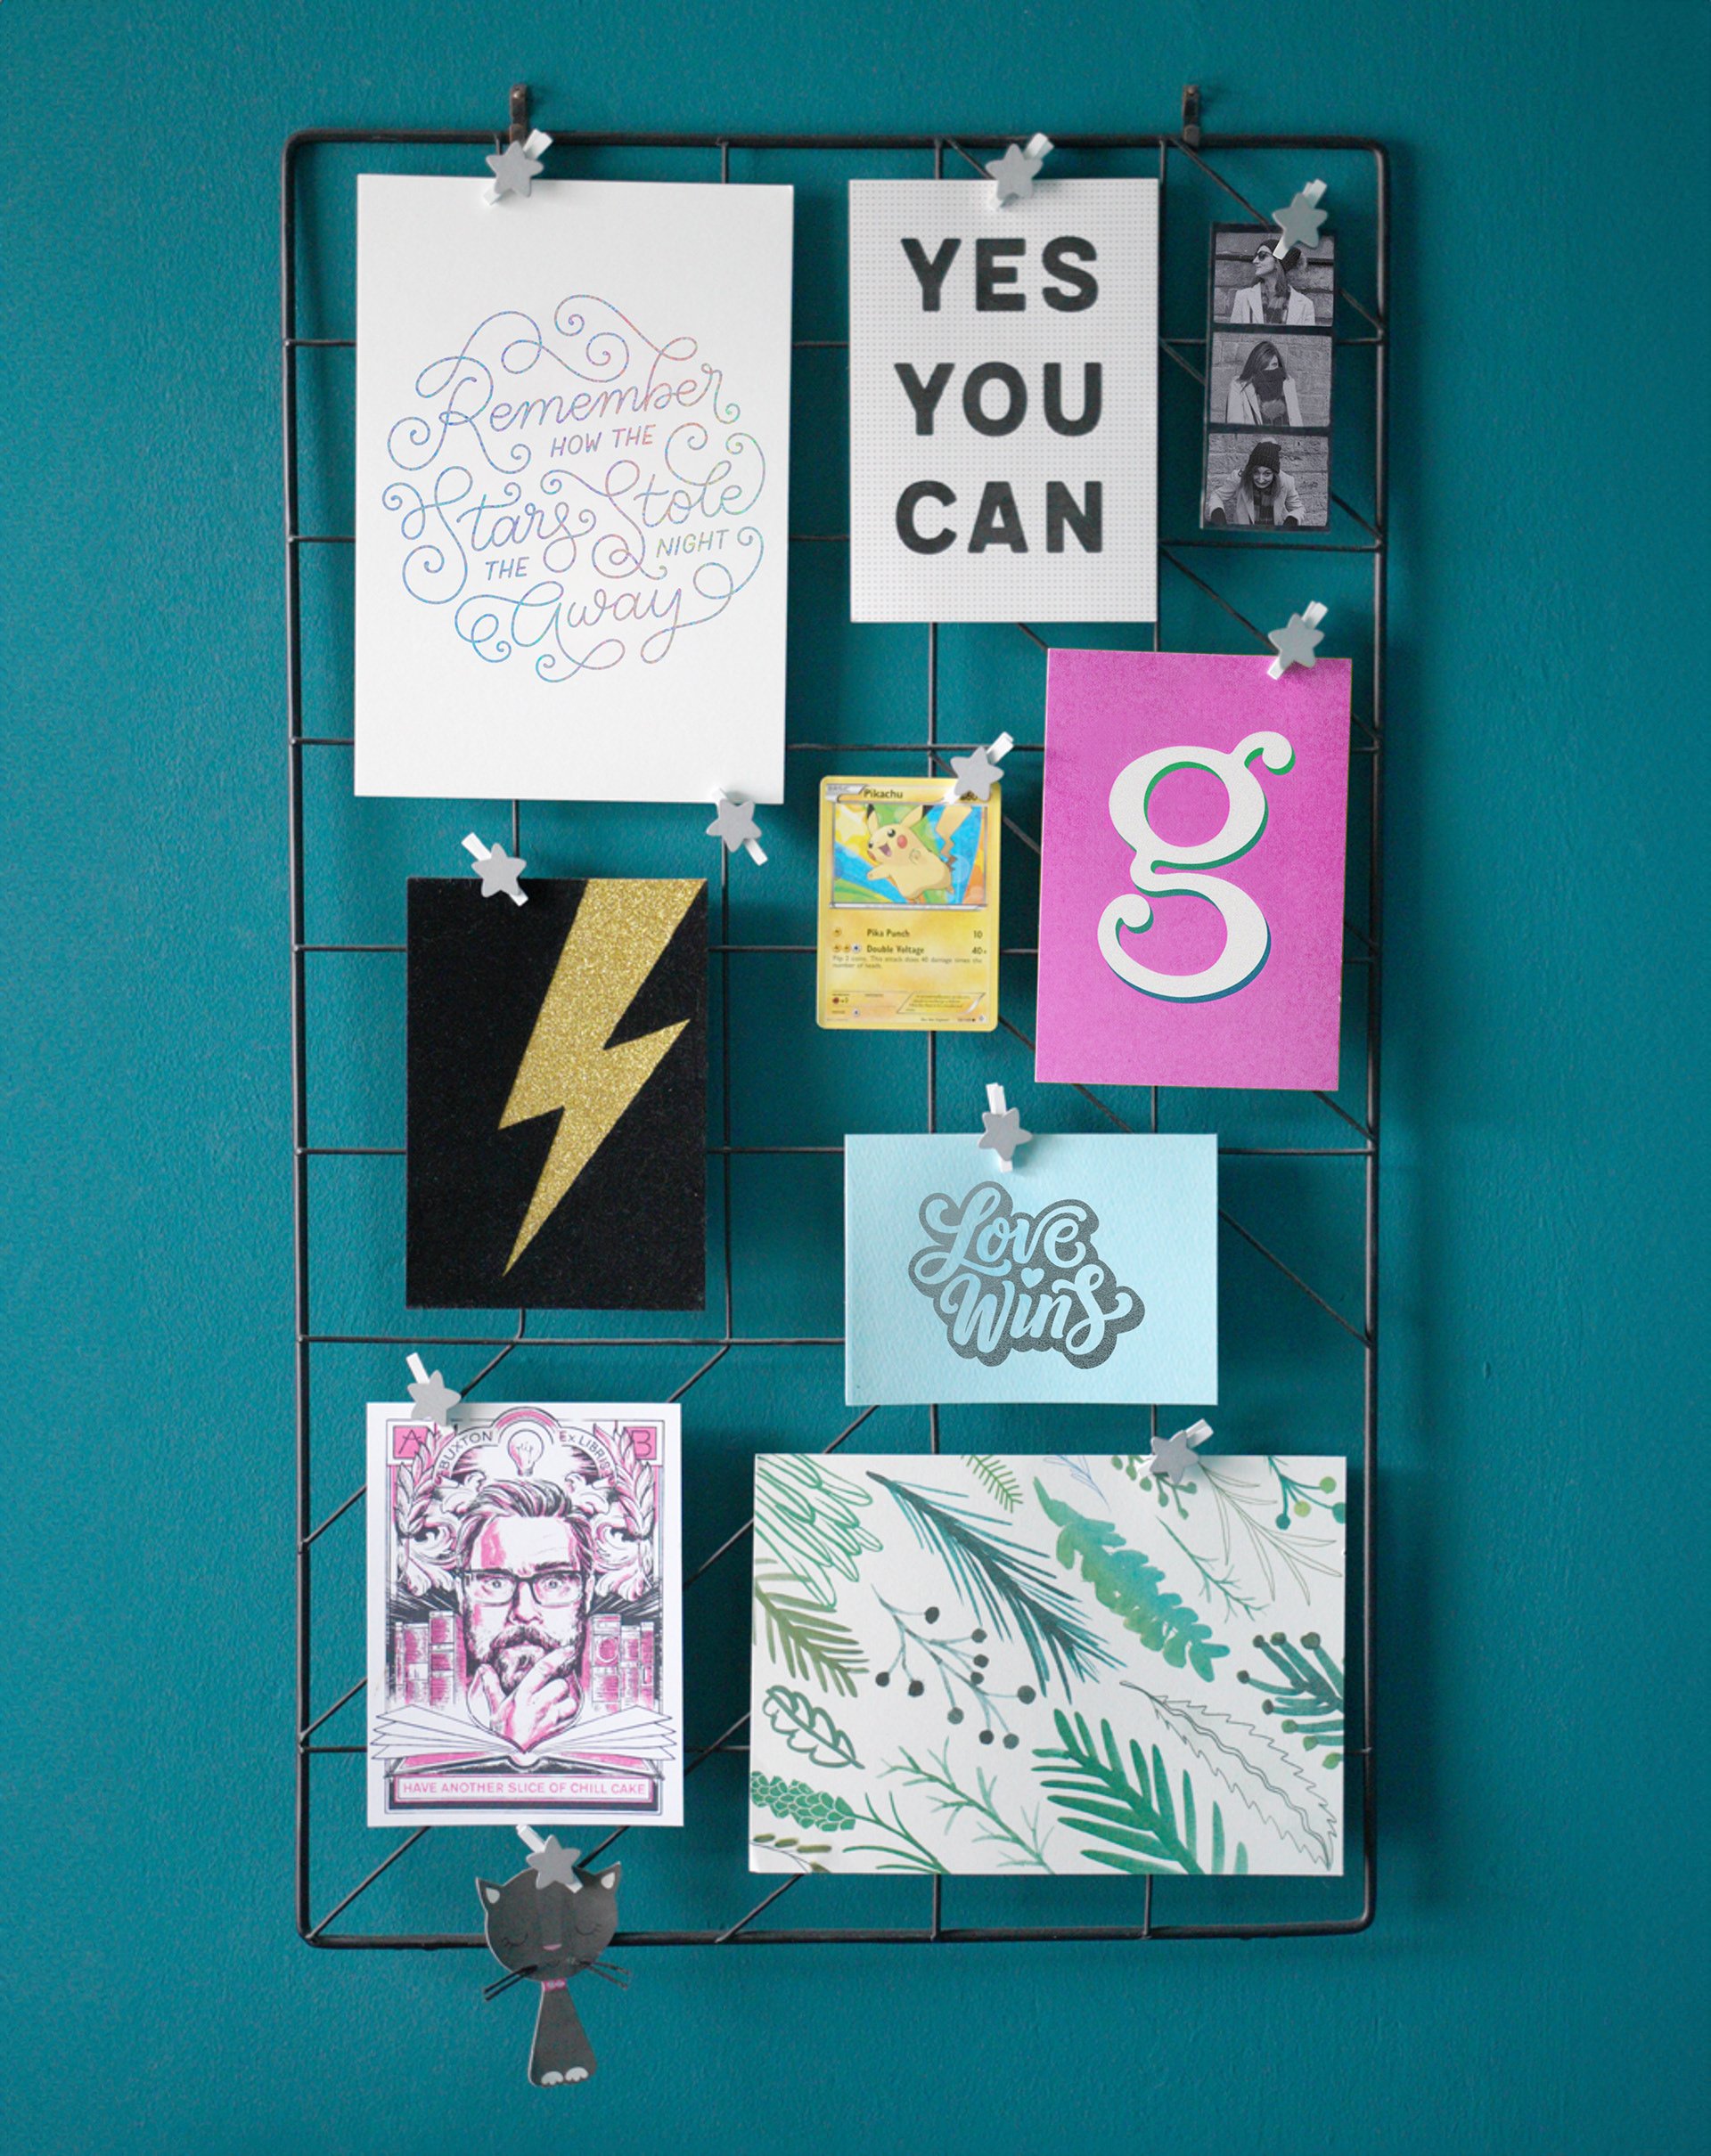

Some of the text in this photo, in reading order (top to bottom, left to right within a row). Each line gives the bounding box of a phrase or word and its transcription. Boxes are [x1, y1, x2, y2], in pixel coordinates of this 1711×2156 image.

[901, 235, 1099, 313] YES
[387, 295, 741, 474] Remember
[894, 361, 1102, 437] YOU
[551, 424, 657, 458] HOW THE
[895, 479, 1102, 555] CAN
[485, 528, 731, 581] THE NIGHT
[864, 788, 904, 799] Pikachu
[1097, 731, 1296, 1003] g
[866, 928, 984, 940] Pika Punch 10
[866, 944, 894, 953] Double
[896, 944, 925, 956] Voltage
[914, 1187, 1087, 1285] Love
[439, 1431, 493, 1469] BUXTON
[578, 1435, 610, 1470] LIBRIS
[632, 1429, 652, 1458] B
[403, 1782, 646, 1794] HAVE ANOTHER SLICE OF CHILL CAKE
